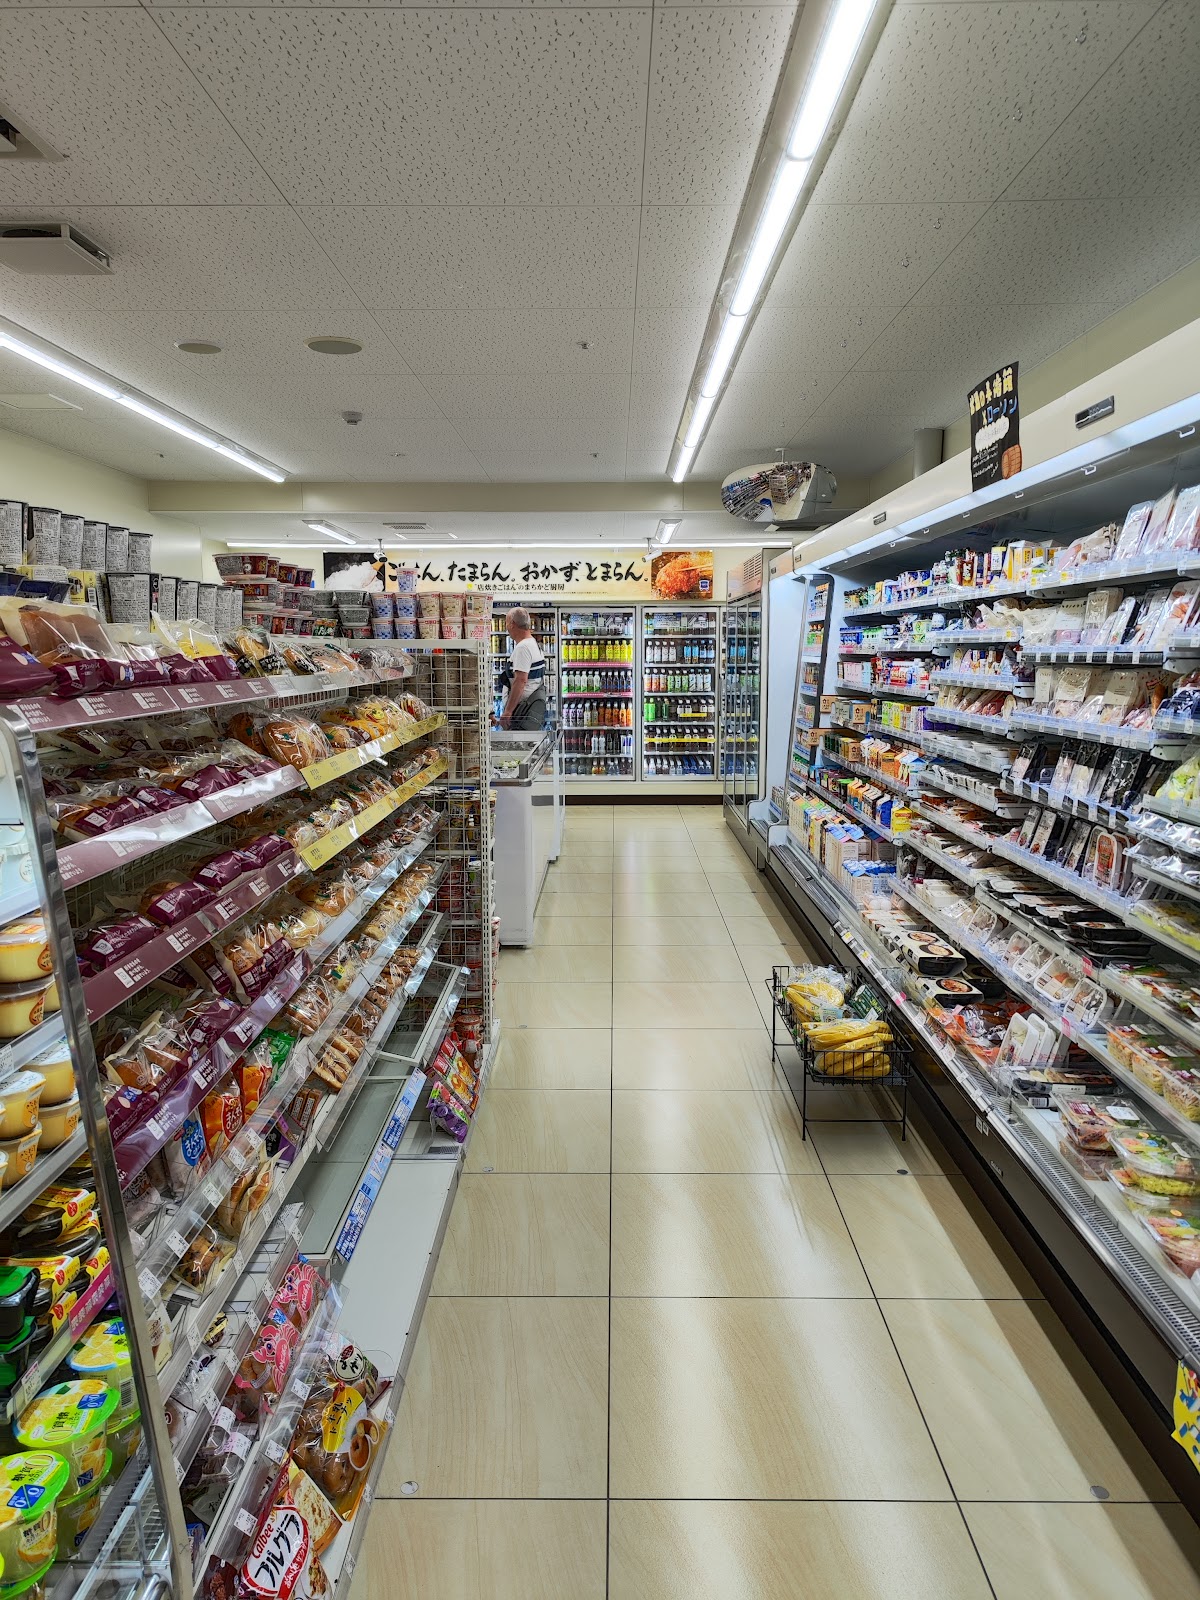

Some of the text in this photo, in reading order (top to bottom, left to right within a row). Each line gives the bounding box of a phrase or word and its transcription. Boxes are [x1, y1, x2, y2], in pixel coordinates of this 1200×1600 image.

[329, 1396, 353, 1435] ドーナツ
[251, 1523, 274, 1559] Calbee
[254, 1513, 300, 1588] フルグラ
